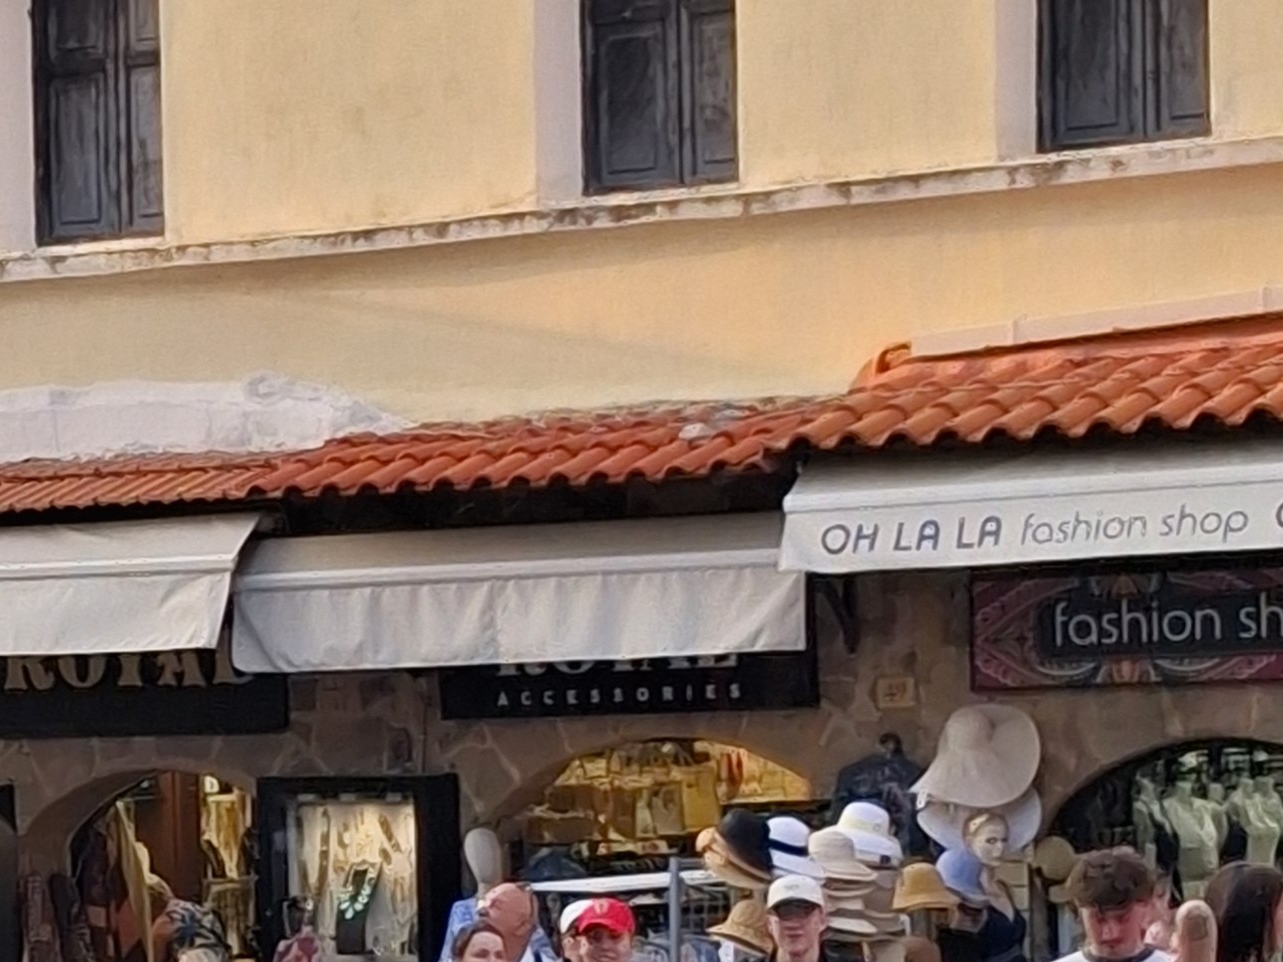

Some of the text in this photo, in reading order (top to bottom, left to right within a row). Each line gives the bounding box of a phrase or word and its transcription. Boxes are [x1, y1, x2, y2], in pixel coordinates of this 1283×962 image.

[821, 518, 879, 555] OH
[893, 520, 940, 552] LA
[956, 516, 1003, 549] LA
[1020, 509, 1147, 545] fashion
[1159, 504, 1250, 544] shop
[1054, 602, 1222, 648] fashion
[496, 684, 740, 706] ACCESSORIES
